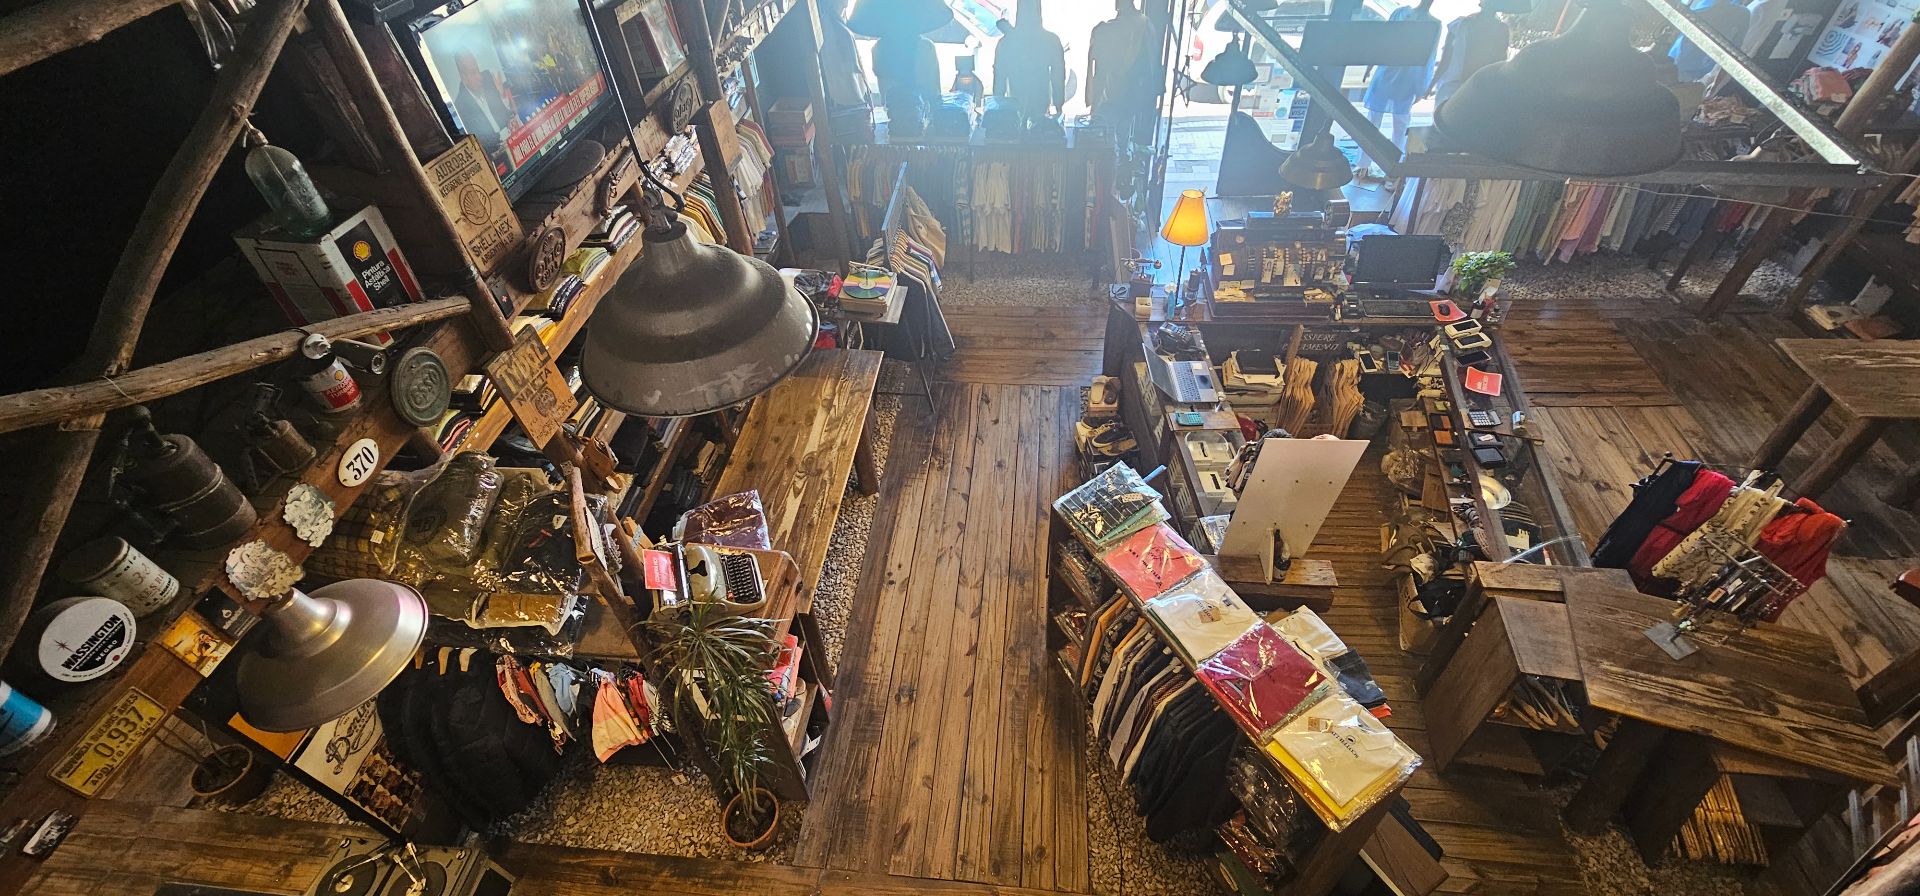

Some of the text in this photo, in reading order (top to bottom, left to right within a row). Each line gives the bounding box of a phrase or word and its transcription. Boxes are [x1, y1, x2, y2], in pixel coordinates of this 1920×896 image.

[434, 148, 472, 182] AURORA
[471, 219, 512, 256] SHELL-MEX
[361, 260, 384, 279] Pintura
[372, 273, 389, 291] Shell
[345, 446, 375, 481] 370
[61, 614, 120, 669] WASSINGTON
[95, 639, 117, 660] NEGRO
[91, 713, 119, 741] BUENOS
[118, 693, 138, 714] AIRES
